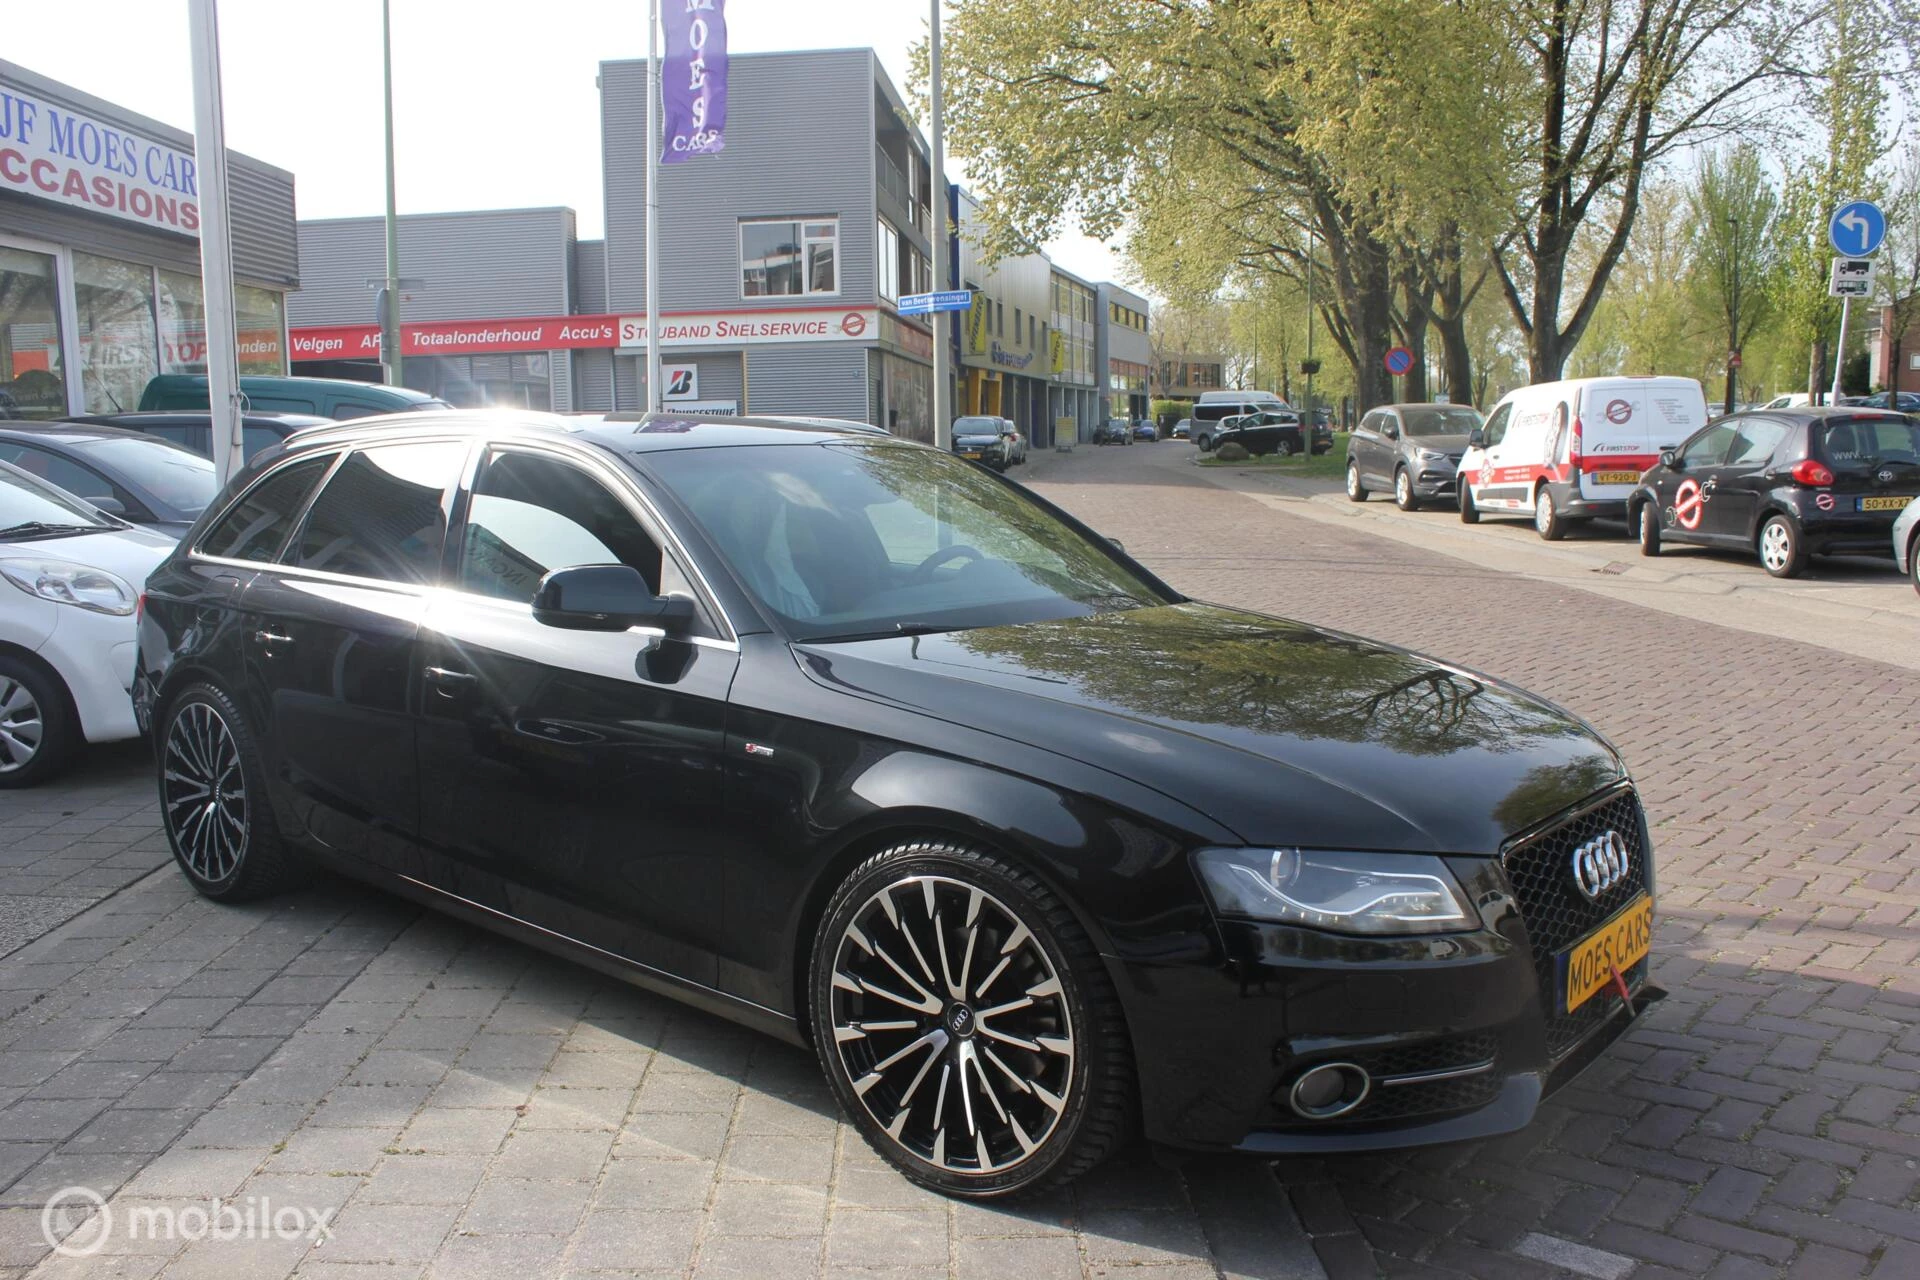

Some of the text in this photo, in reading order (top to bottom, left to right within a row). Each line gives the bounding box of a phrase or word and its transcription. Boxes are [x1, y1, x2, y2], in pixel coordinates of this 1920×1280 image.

[48, 109, 138, 178] MOES
[293, 337, 343, 353] Velgen
[412, 327, 542, 346] Totaalonderhoud
[559, 324, 613, 340] Accu's
[623, 321, 828, 340] STUBAND SNELSERVICE
[1571, 907, 1651, 996] MOES CARS
